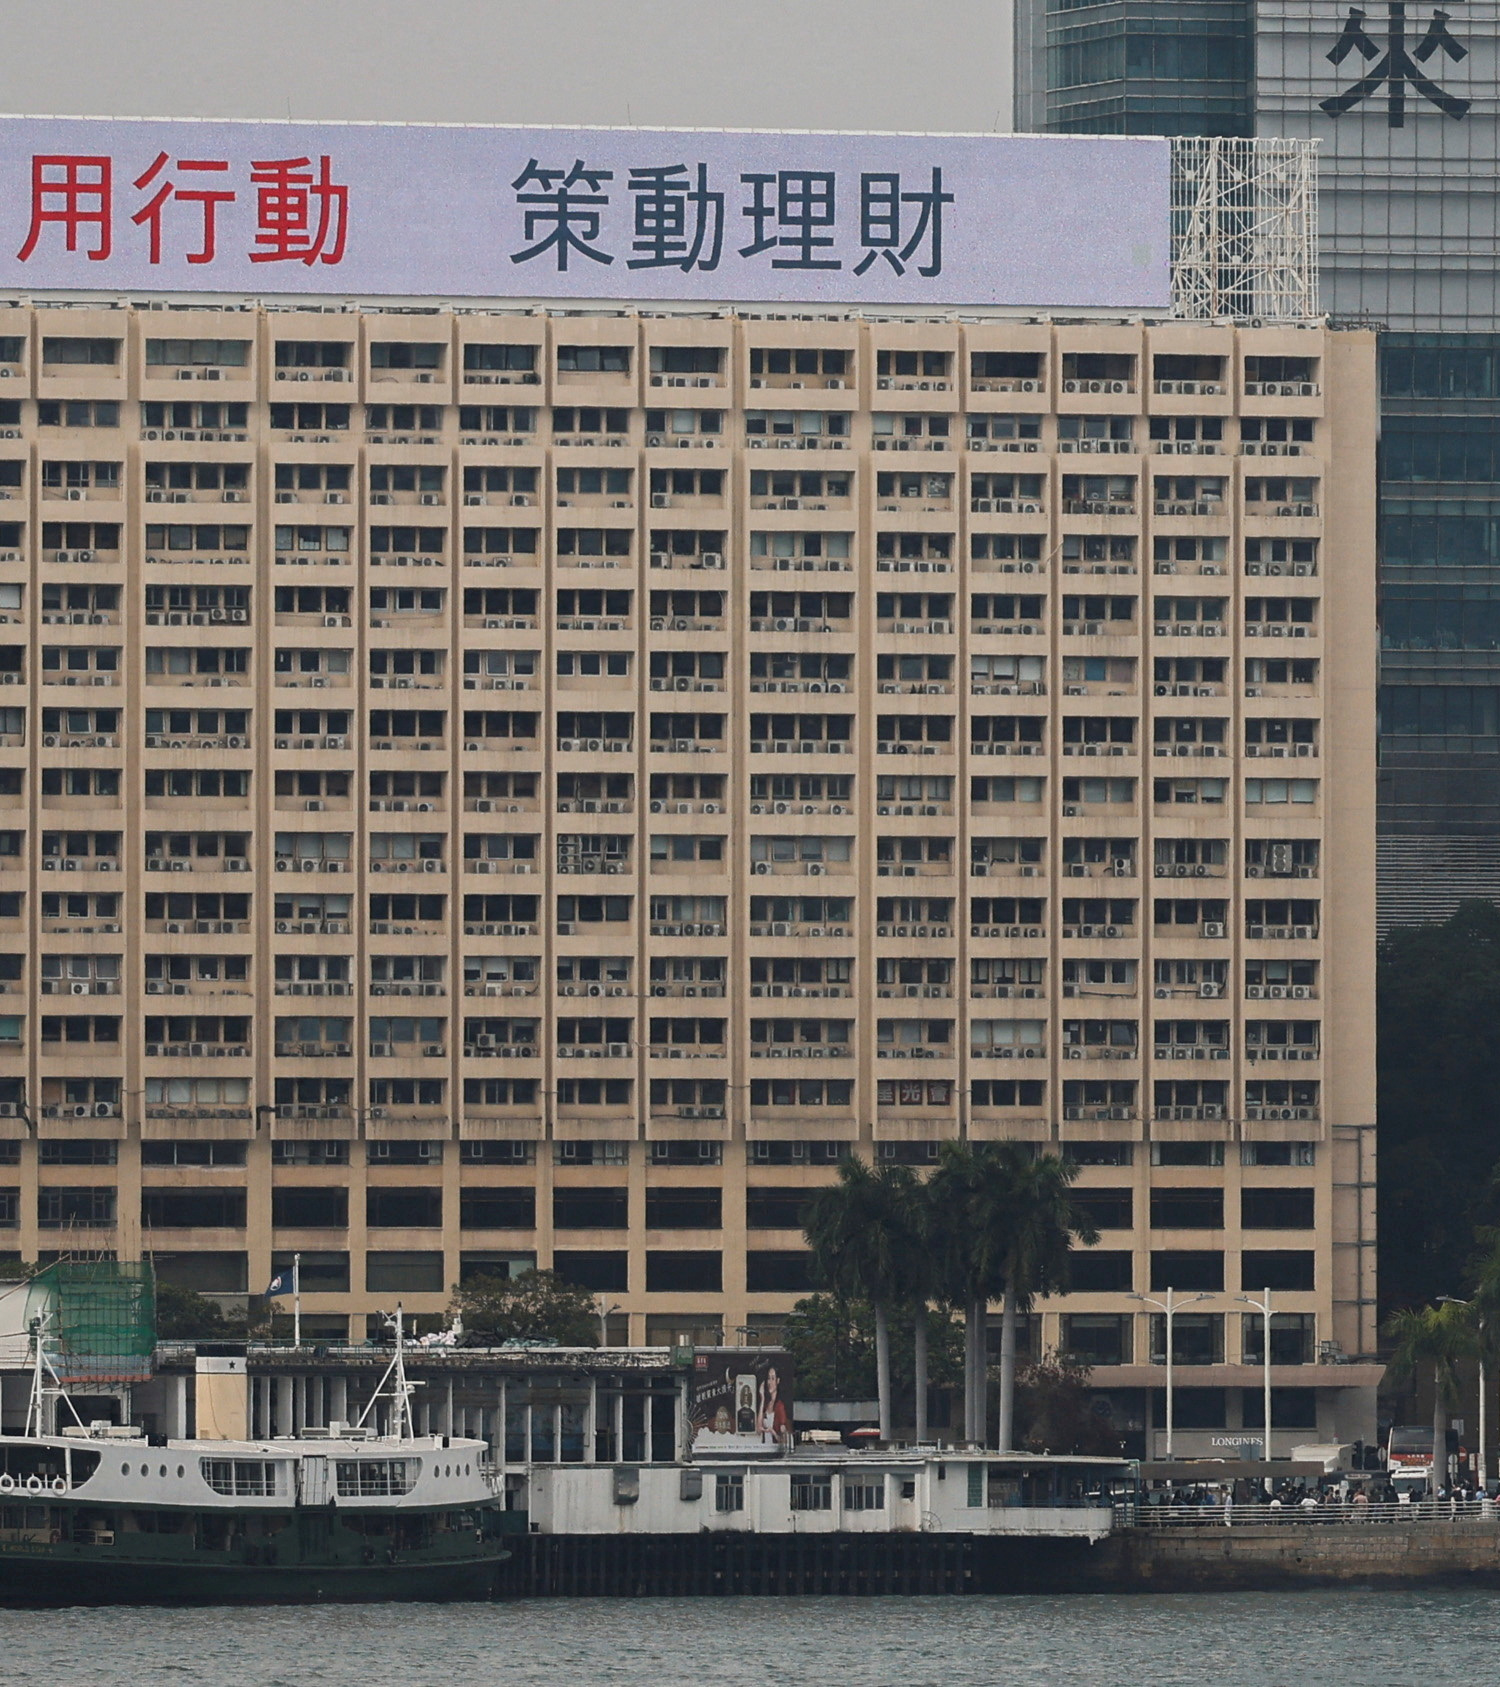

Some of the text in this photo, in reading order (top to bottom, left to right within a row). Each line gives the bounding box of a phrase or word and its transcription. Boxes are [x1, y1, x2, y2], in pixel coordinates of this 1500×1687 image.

[16, 153, 956, 278] 用行動 策動理財
[1211, 1437, 1264, 1446] LONGINES
